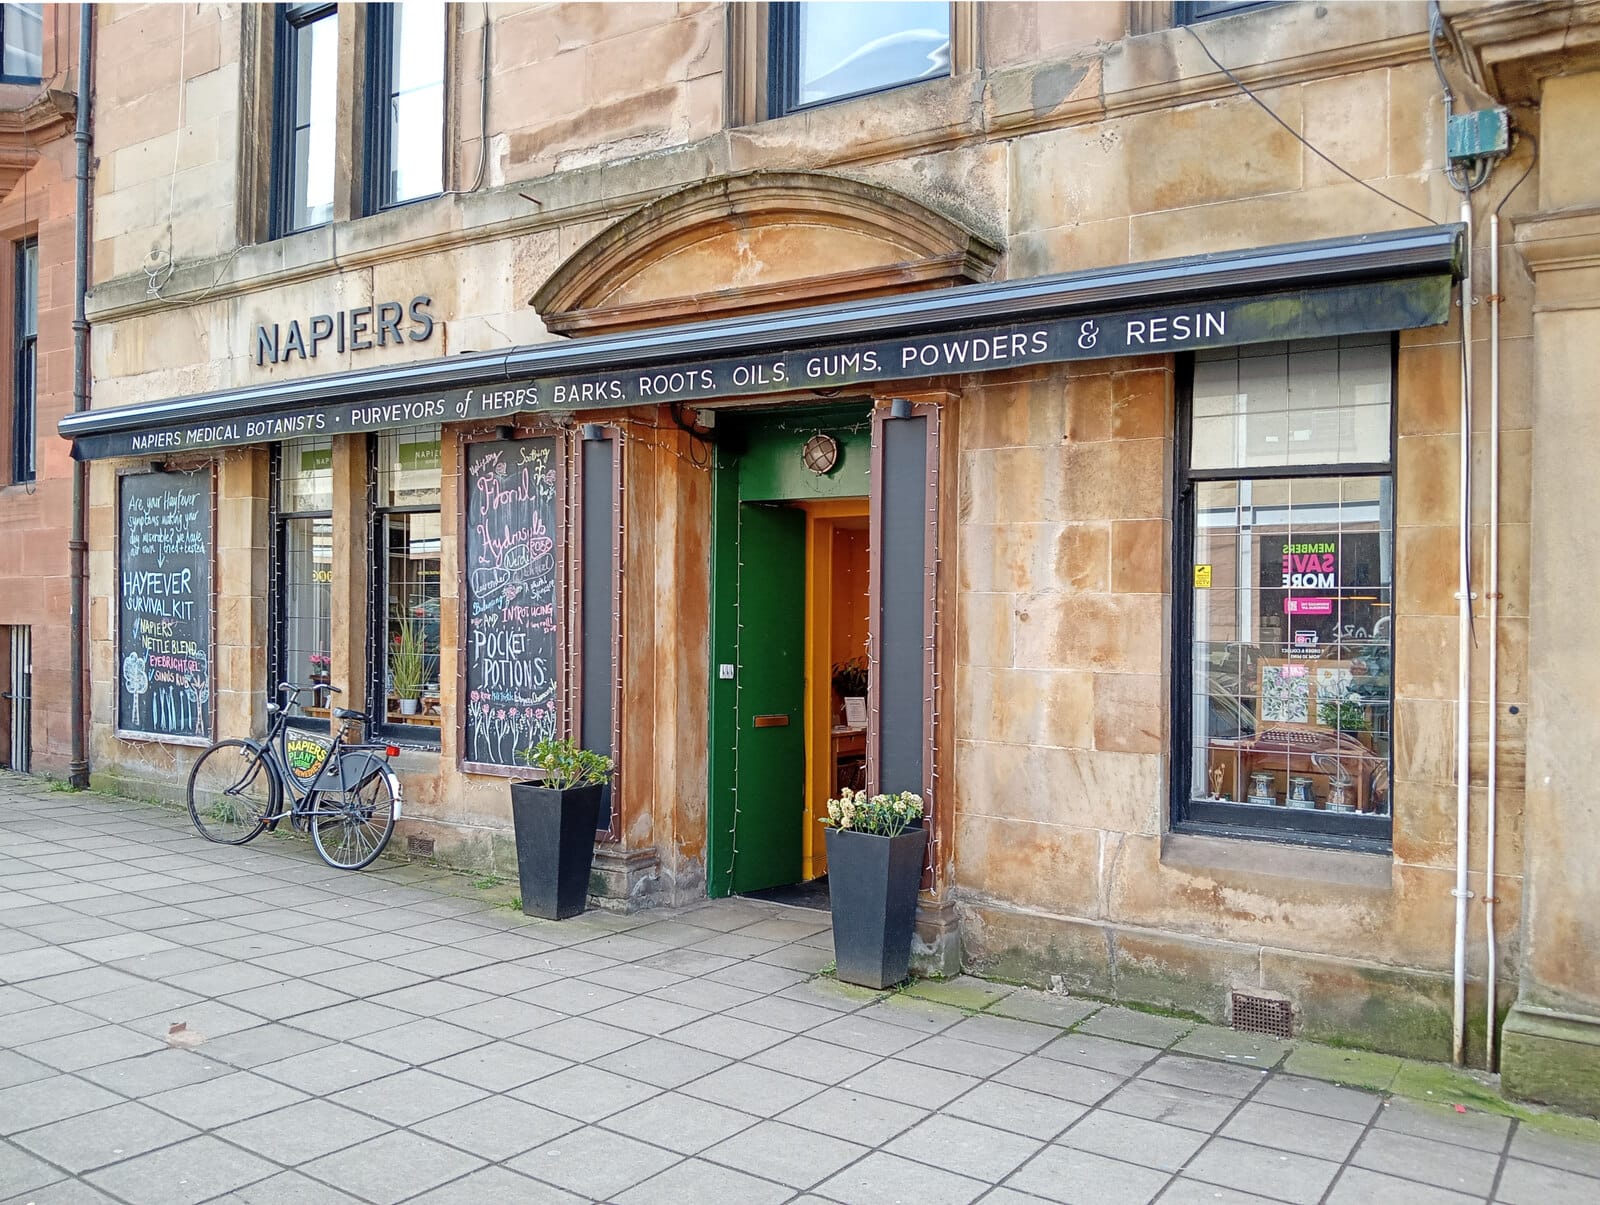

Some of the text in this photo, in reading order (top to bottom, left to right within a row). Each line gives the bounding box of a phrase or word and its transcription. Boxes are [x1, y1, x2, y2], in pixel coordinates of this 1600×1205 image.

[256, 295, 433, 365] NAPIERS
[132, 431, 181, 450] NAPIERS
[186, 425, 240, 444] MEDICAL
[246, 413, 325, 437] BOTANISTS
[351, 399, 445, 426] PURVEYORS
[456, 390, 473, 418] of
[553, 380, 626, 403] BARKS,
[639, 370, 717, 397] ROOTS,
[733, 362, 790, 386] OILS,
[806, 351, 882, 379] GUMS,
[901, 331, 1048, 369] POWDERS
[1077, 320, 1099, 350] &
[1126, 311, 1226, 346] RESIN
[477, 468, 536, 516] Floral
[129, 495, 144, 512] Are
[144, 496, 163, 515] your
[183, 510, 199, 530] your
[123, 568, 192, 596] HAYFEVER
[125, 595, 194, 620] SURVIVAL KIT
[140, 618, 173, 638] NAPIERS
[484, 613, 499, 628] AND
[141, 635, 197, 655] NETTLE BLEND
[474, 630, 527, 661] POCKET
[483, 657, 544, 689] POTIONS
[288, 740, 327, 762] NAPIERS
[288, 751, 316, 764] PLANT
